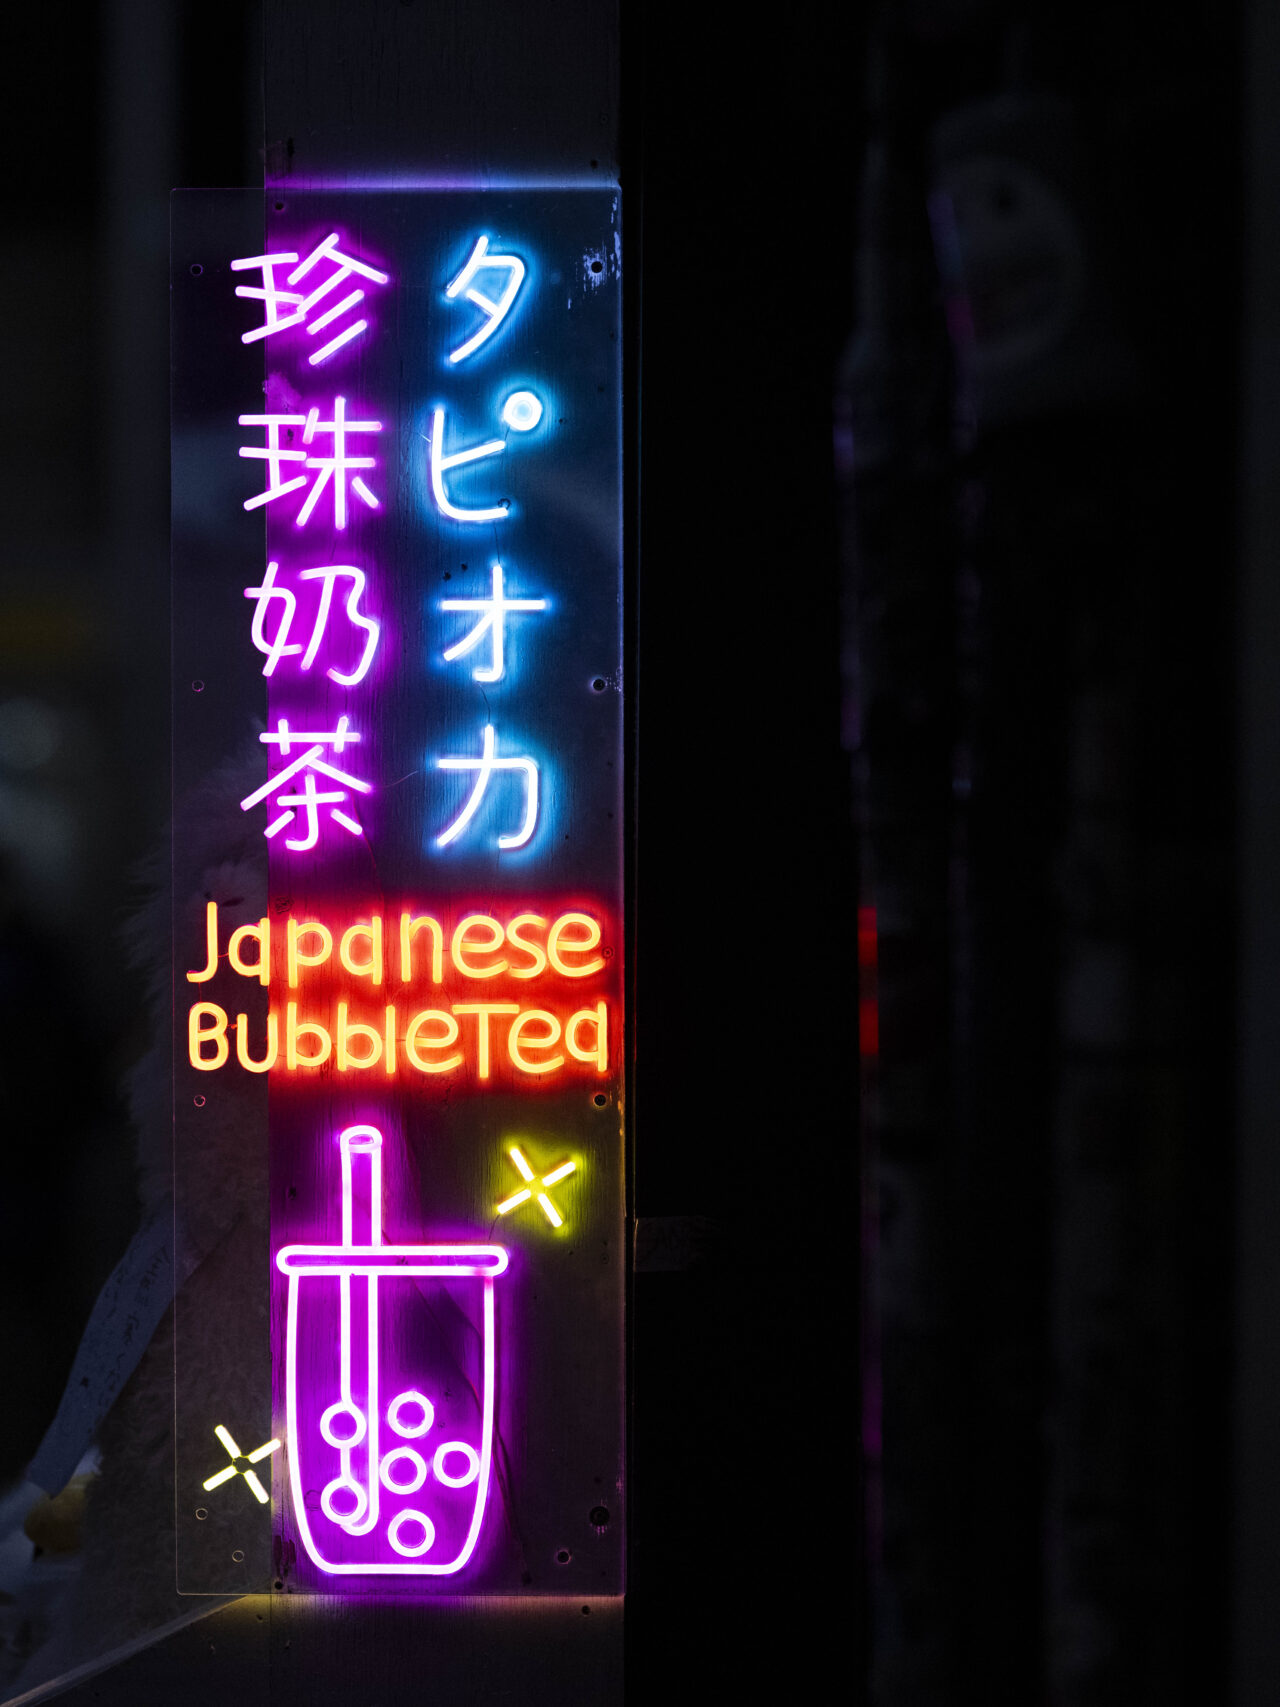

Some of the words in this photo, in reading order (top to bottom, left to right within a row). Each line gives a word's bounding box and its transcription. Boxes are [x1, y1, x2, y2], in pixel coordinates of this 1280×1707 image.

[231, 233, 388, 851] 珍珠奶茶
[428, 235, 547, 849] タピオカ
[186, 901, 605, 988] Japanese
